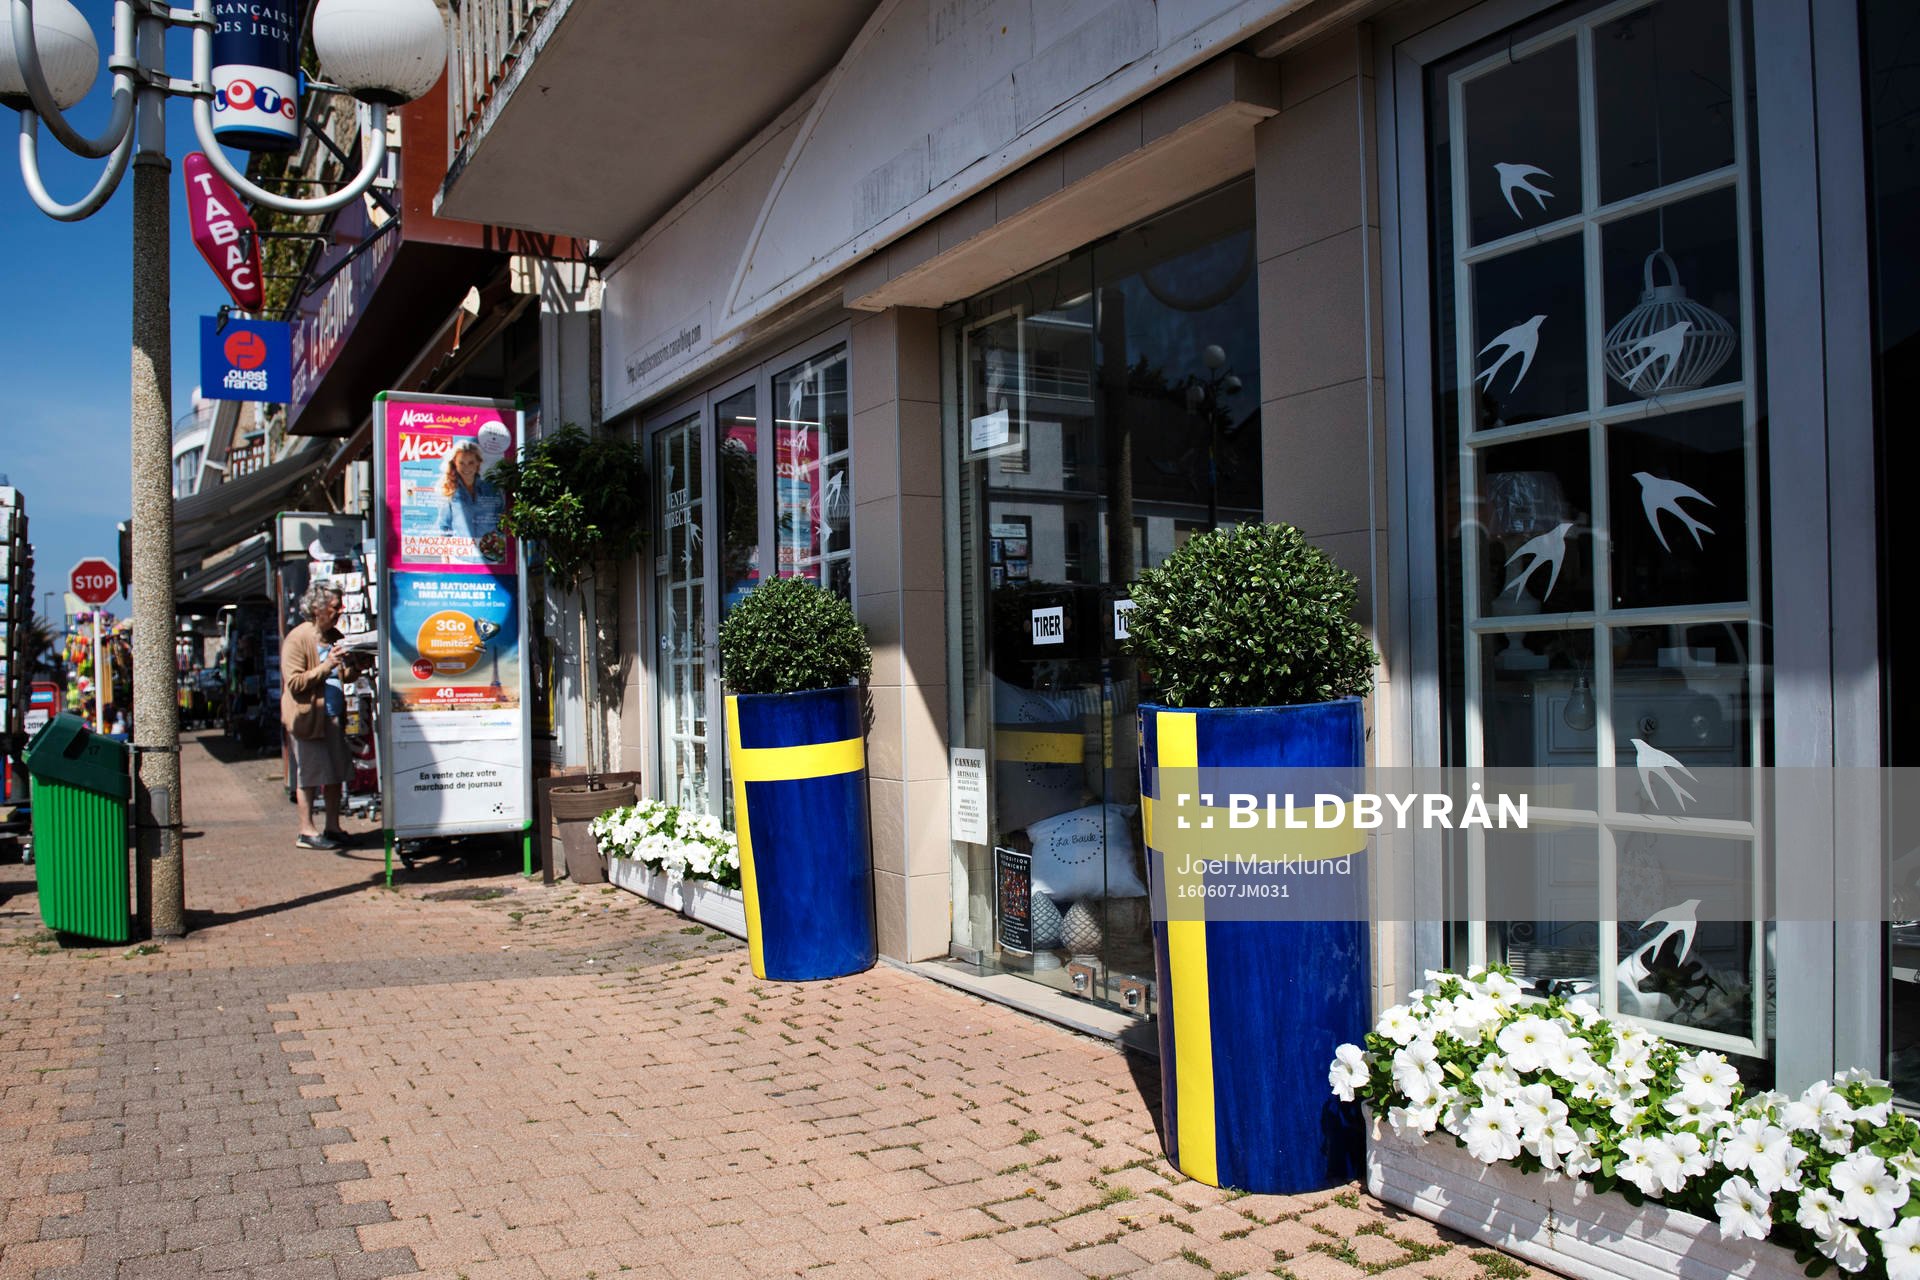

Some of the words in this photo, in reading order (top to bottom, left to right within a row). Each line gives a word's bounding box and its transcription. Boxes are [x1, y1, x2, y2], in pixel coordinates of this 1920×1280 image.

[214, 21, 243, 35] DES
[249, 22, 290, 42] JEUX
[214, 78, 297, 120] LOTO
[193, 172, 256, 291] TABAC
[222, 375, 268, 391] france
[227, 369, 268, 382] ouest
[399, 408, 435, 427] Maxi
[400, 434, 453, 462] Maxi
[666, 488, 688, 509] VENTE
[404, 536, 416, 546] LA
[419, 536, 477, 546] MOZZARELLA
[404, 546, 421, 555] ON
[423, 546, 454, 556] ADORE
[75, 575, 114, 590] STOP
[412, 581, 438, 591] PASS
[440, 582, 496, 592] NATIONAUX
[418, 591, 486, 600] IMBATTABLES
[1034, 614, 1062, 637] TIRER
[954, 757, 981, 769] CANNAGE
[419, 772, 430, 780] En
[432, 771, 454, 780] vente
[455, 769, 474, 778] chez
[476, 769, 497, 777] votre
[414, 783, 454, 791] marchand
[456, 781, 466, 789] de
[468, 780, 502, 790] journaux
[1055, 837, 1069, 847] La
[1071, 831, 1098, 844] Baule
